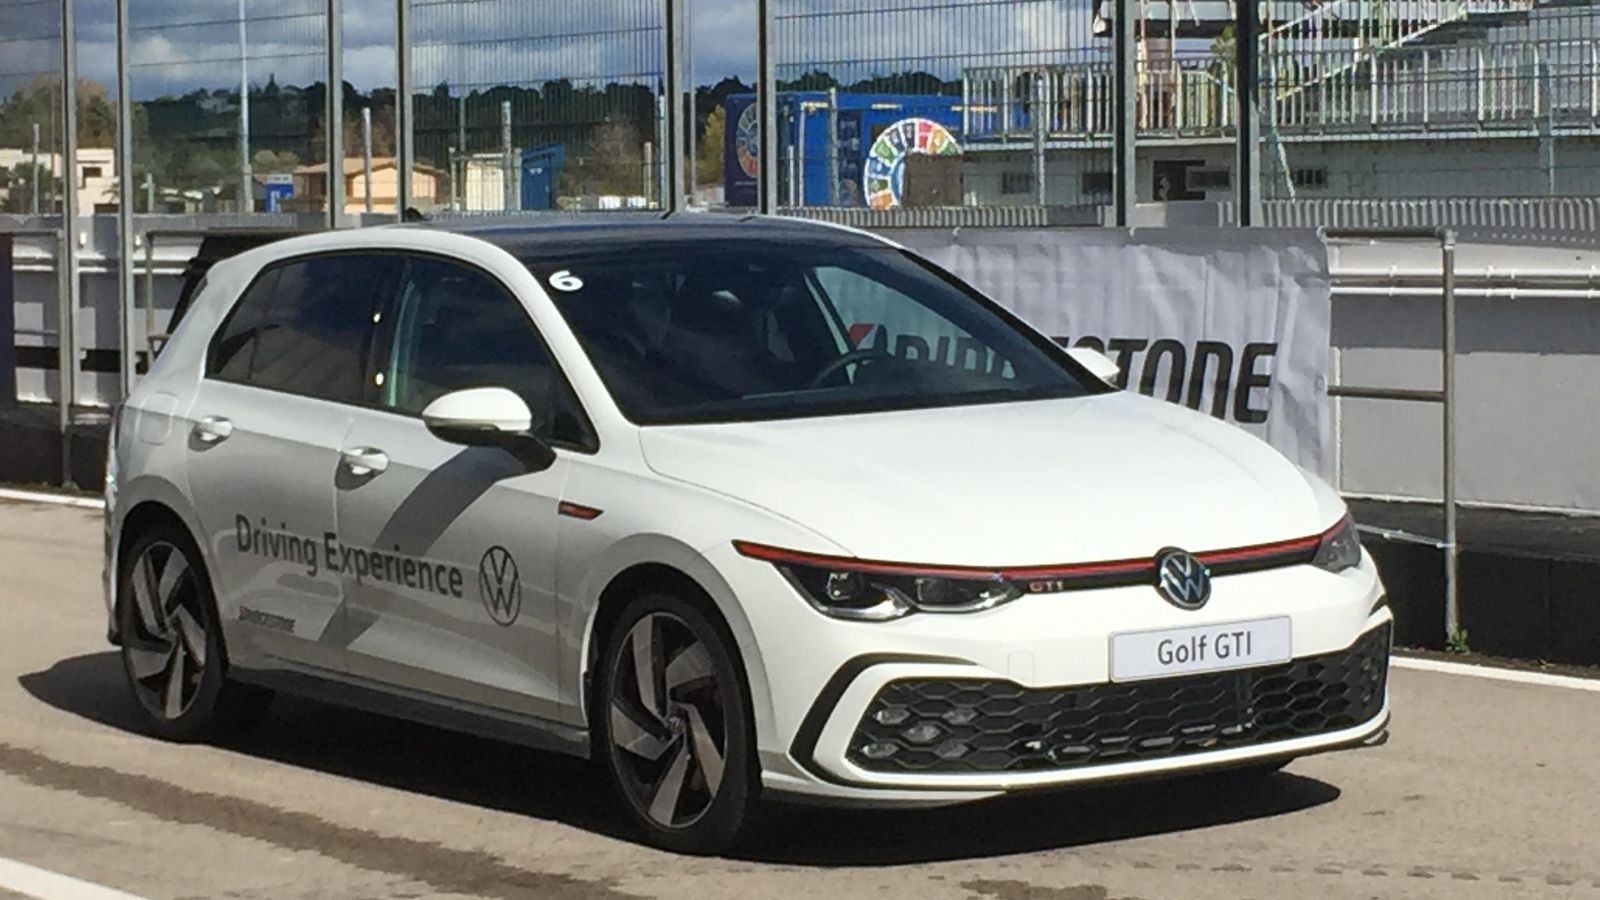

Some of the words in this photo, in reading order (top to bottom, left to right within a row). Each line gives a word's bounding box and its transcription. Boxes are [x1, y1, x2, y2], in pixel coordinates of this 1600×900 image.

[549, 270, 584, 291] 6
[235, 513, 318, 578] Driving
[323, 531, 464, 599] Experience
[479, 545, 522, 627] VW
[1029, 580, 1064, 592] GTI
[1160, 551, 1208, 608] VW
[1157, 634, 1207, 666] Golf
[1214, 630, 1252, 660] GTI
